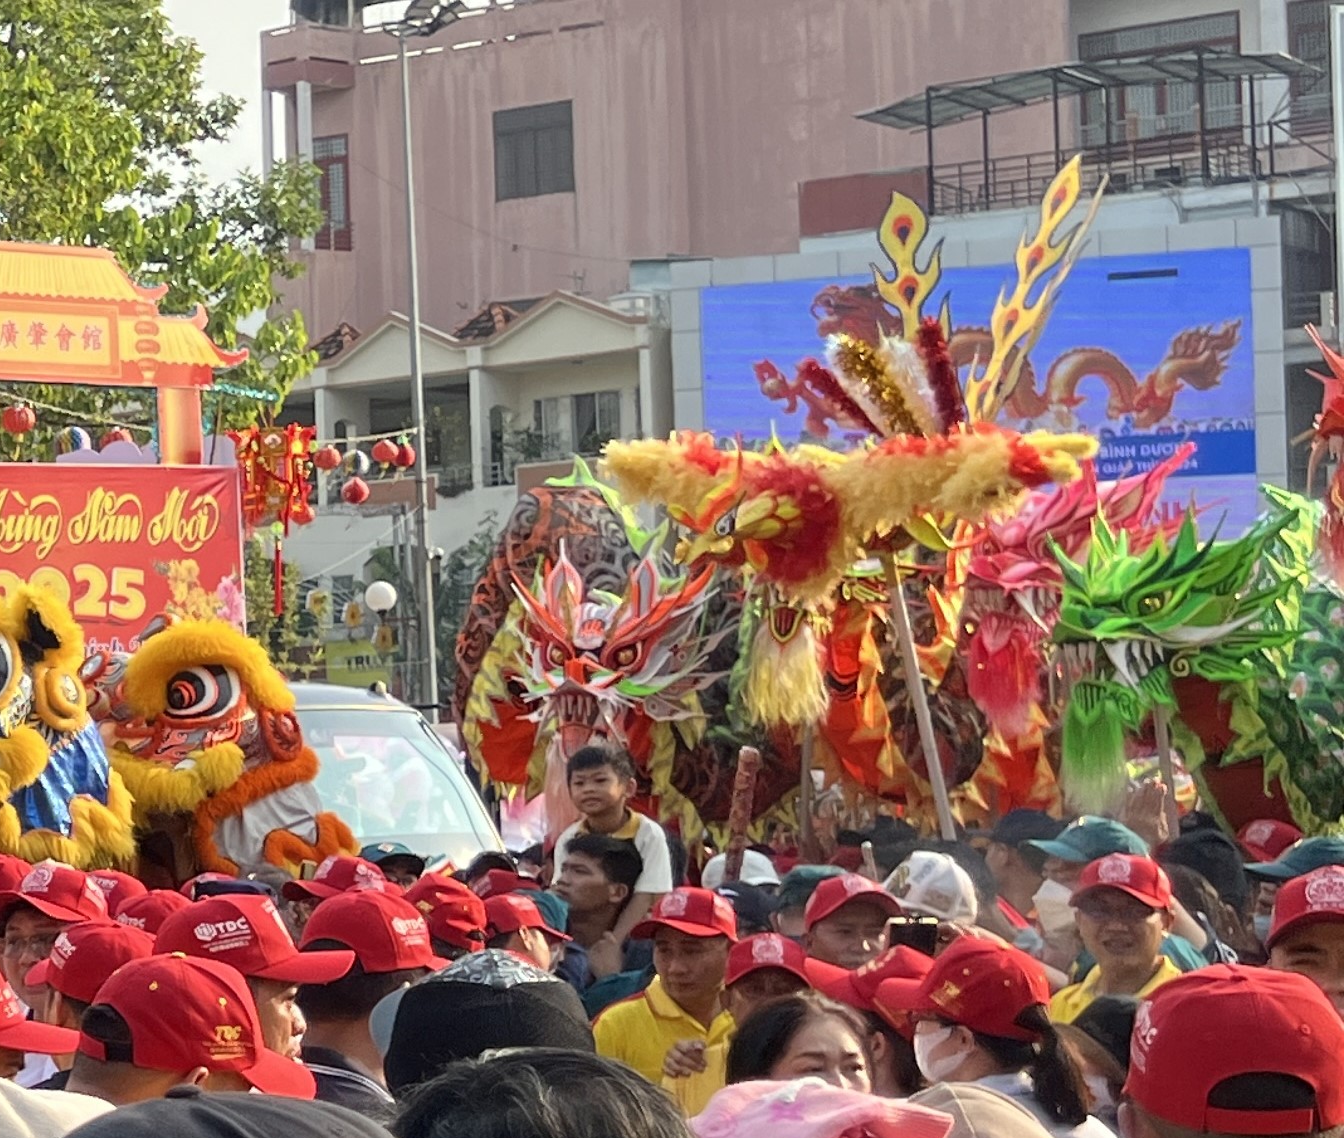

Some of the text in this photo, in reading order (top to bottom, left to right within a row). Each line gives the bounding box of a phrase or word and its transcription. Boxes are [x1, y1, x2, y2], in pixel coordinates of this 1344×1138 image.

[67, 486, 144, 546] Năm
[147, 486, 220, 553] Mới
[215, 916, 249, 934] TDC
